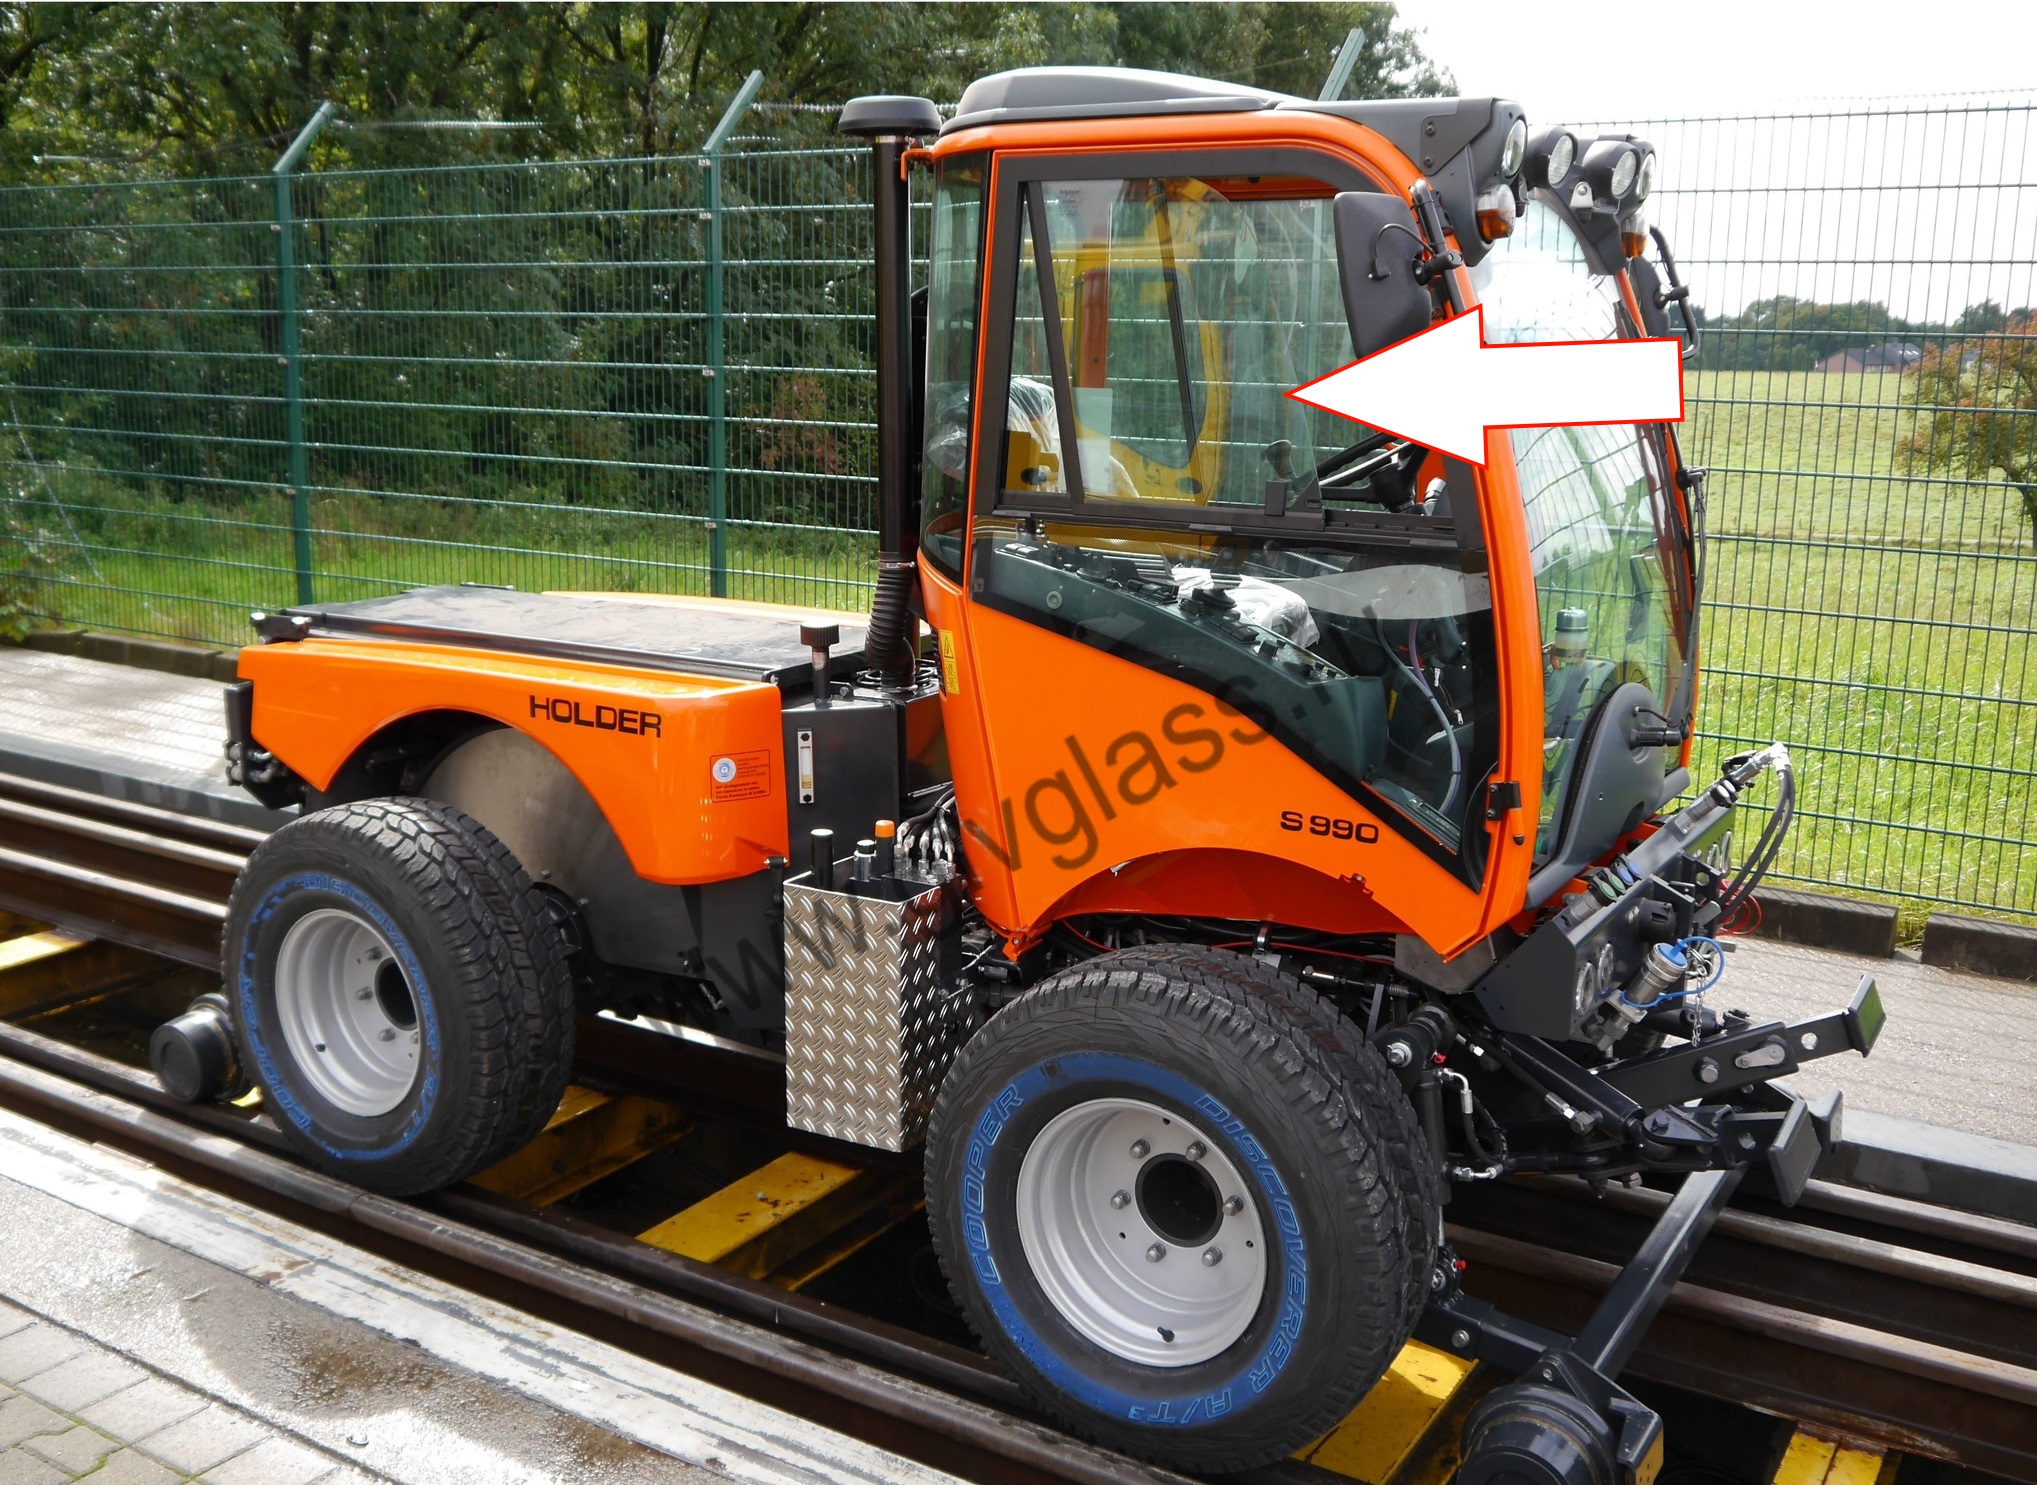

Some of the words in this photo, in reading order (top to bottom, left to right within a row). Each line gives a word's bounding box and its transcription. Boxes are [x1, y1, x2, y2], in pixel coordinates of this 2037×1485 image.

[529, 695, 662, 738] HOLDER
[1280, 810, 1303, 831] S
[1309, 815, 1379, 844] 990
[962, 1084, 1025, 1285] COOPER
[1195, 1094, 1307, 1393] DISCOVERER
